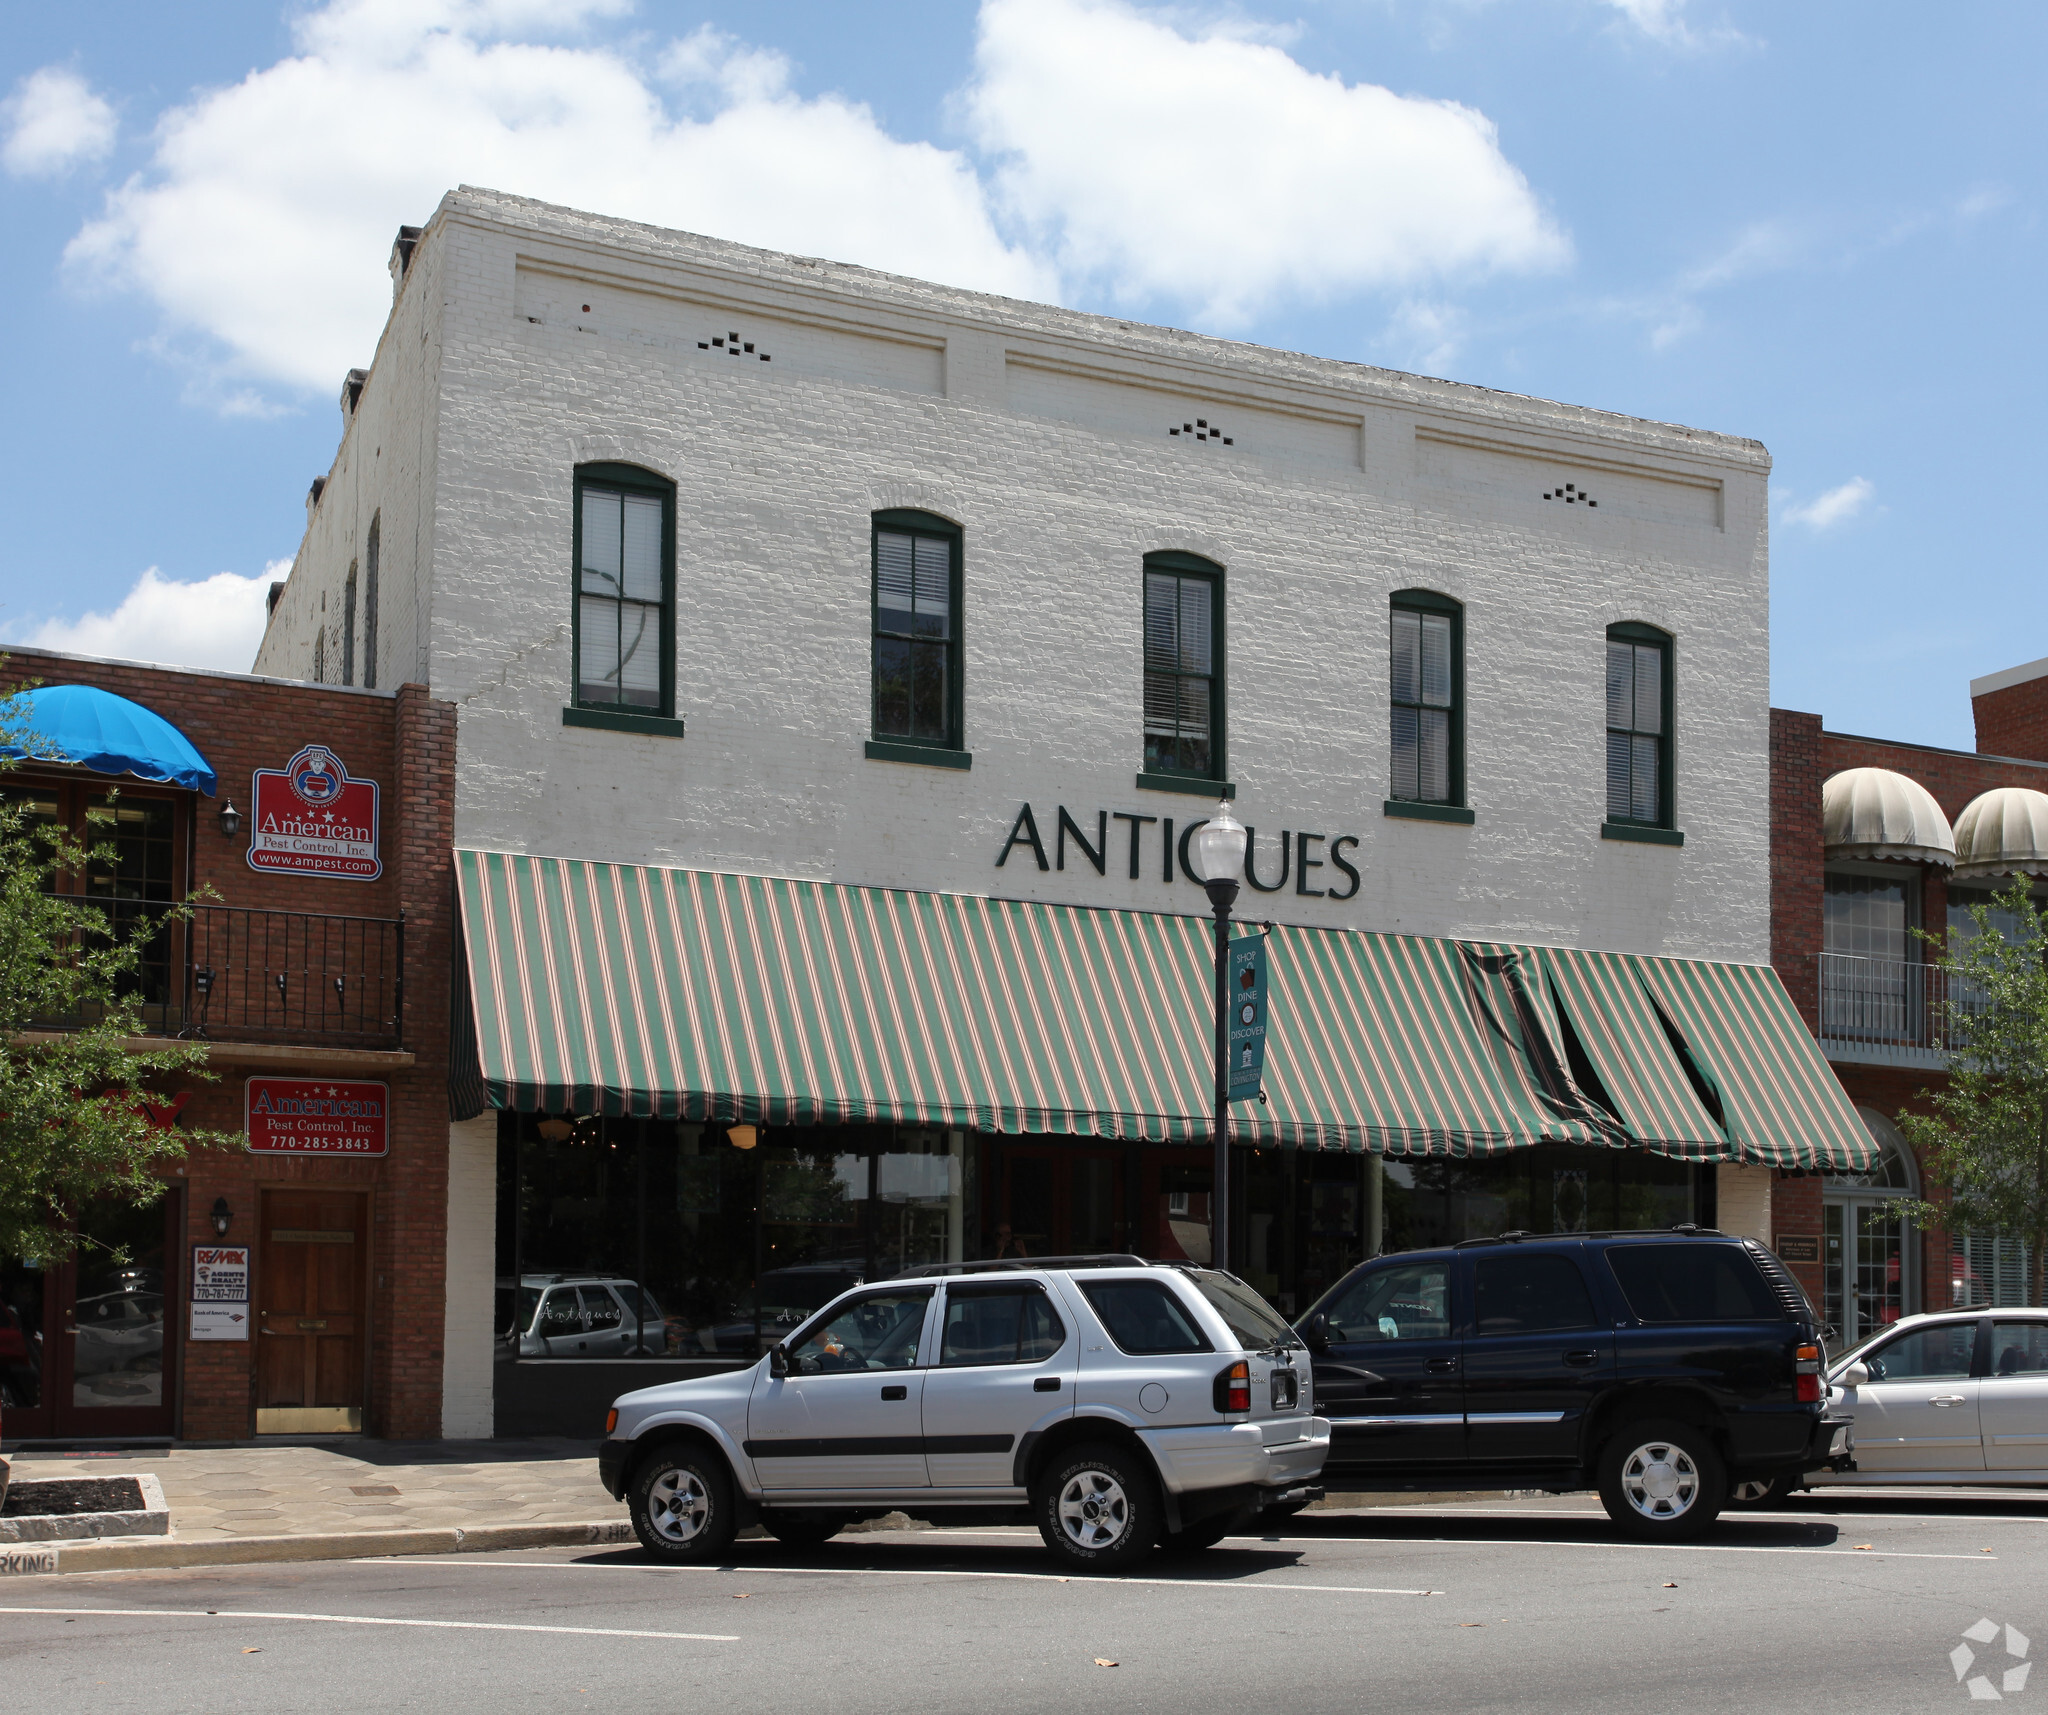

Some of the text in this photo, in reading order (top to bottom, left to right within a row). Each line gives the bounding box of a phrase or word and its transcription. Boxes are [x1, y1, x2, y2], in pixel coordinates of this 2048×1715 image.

[260, 812, 370, 842] American
[263, 836, 369, 857] Pest Control, Inc.
[259, 853, 371, 872] www.ampest.com
[1236, 951, 1257, 964] SHOP
[1237, 990, 1258, 1002] DINE
[1231, 1026, 1265, 1040] DISCOVER
[1231, 1072, 1260, 1086] COVINGTON
[252, 1088, 382, 1118] American
[267, 1118, 375, 1133] Pest Control, Inc.
[271, 1136, 370, 1150] 770-285-3843
[197, 1250, 246, 1265] RE/MAX
[539, 1304, 621, 1326] Antiques
[1060, 1461, 1126, 1485] WRANGLER
